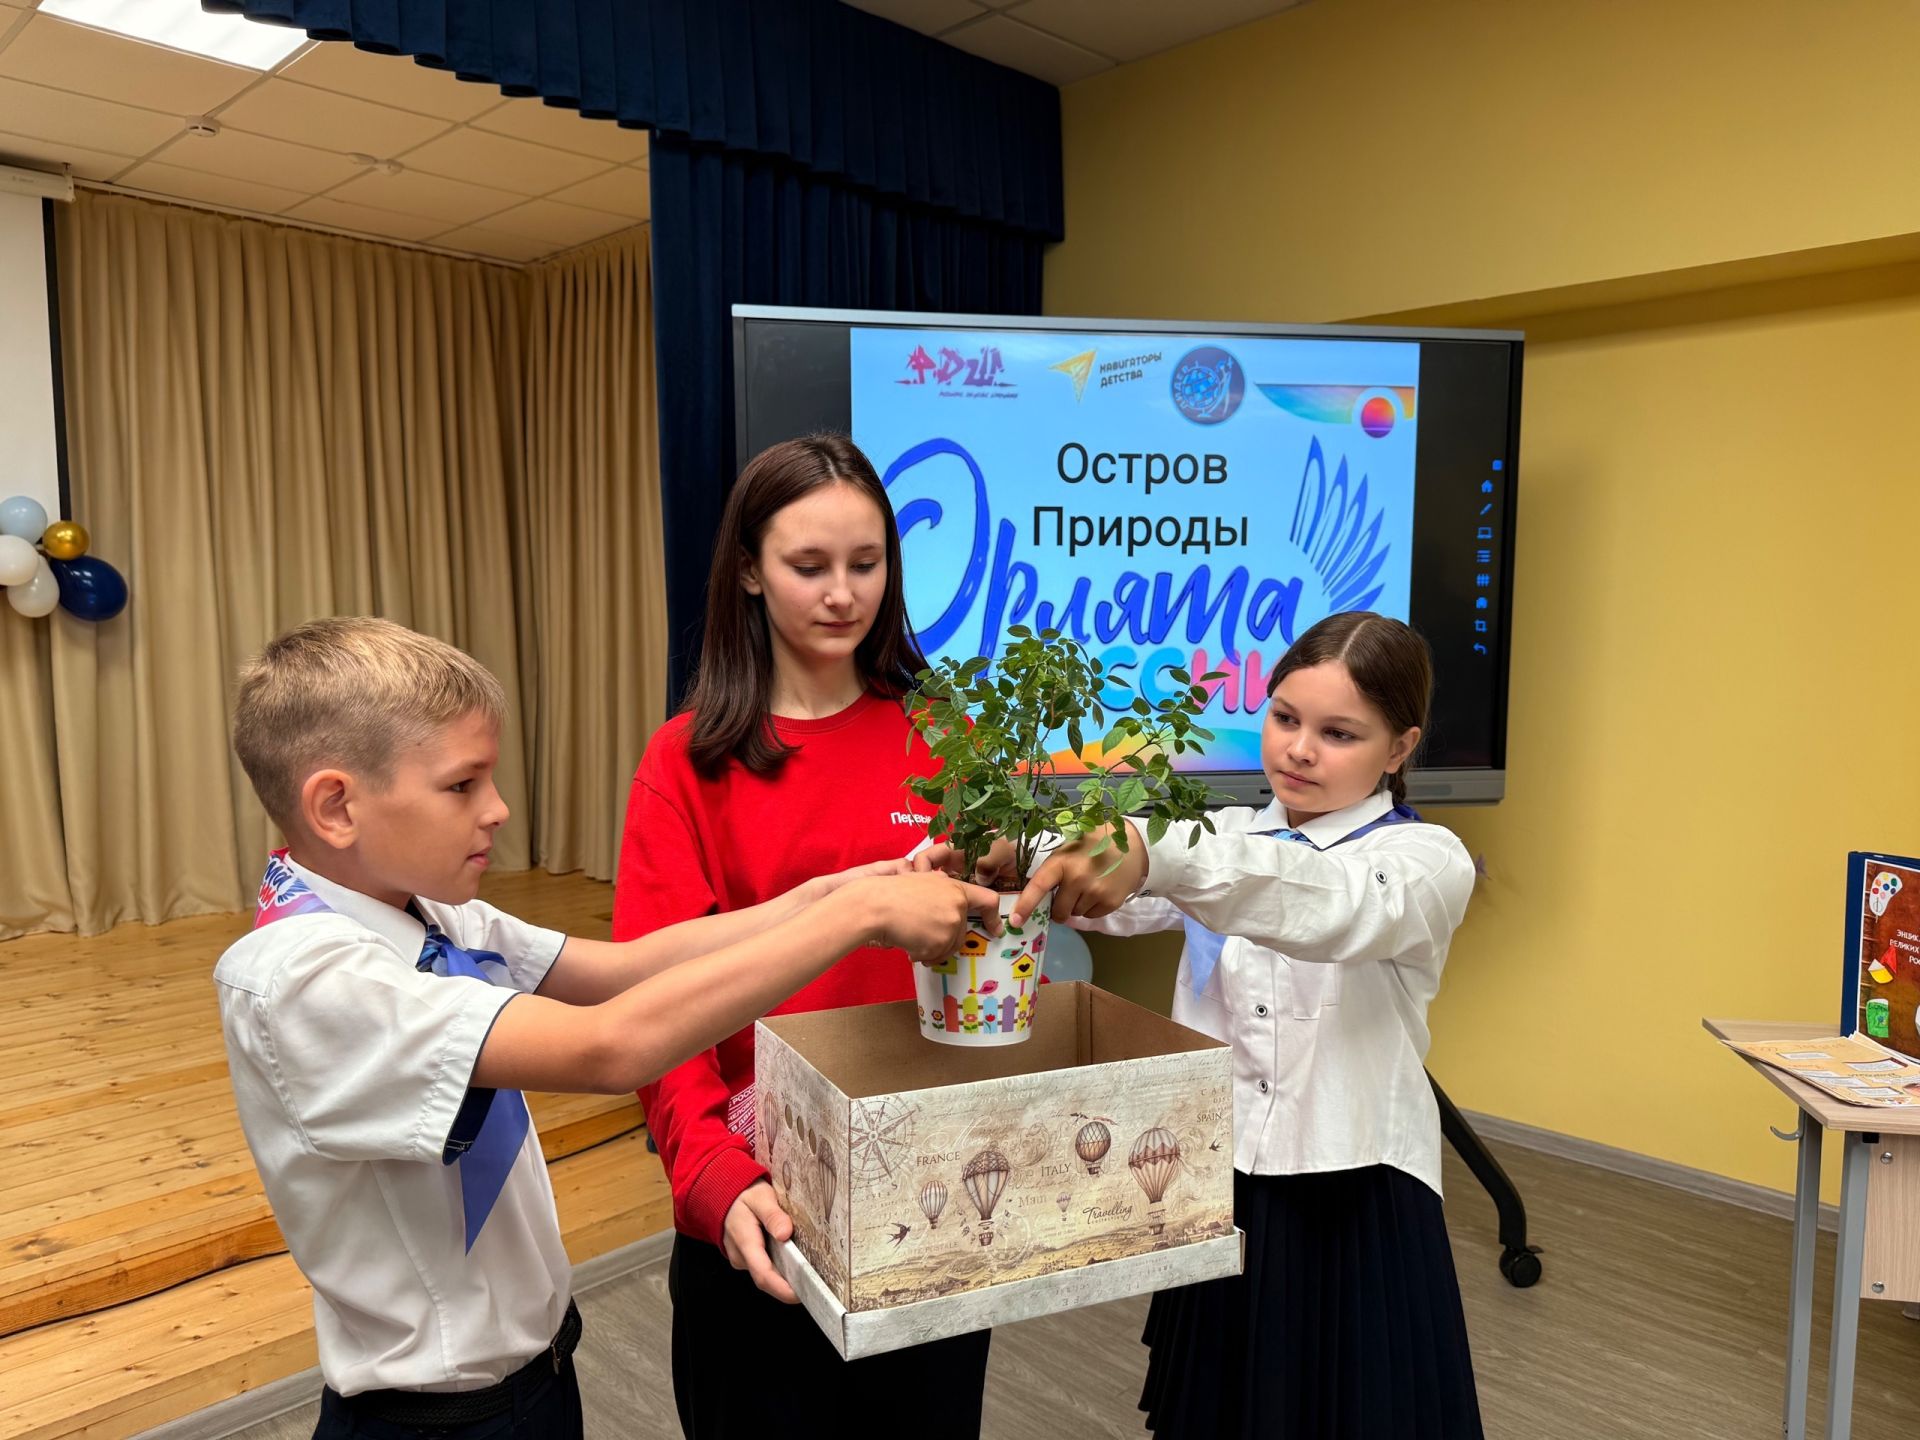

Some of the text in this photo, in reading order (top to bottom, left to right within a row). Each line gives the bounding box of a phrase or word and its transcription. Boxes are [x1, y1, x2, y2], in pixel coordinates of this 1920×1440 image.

[1099, 352, 1162, 374] НАВИГАТОРЫ
[1100, 369, 1143, 388] ДЕТСТВА
[1056, 442, 1228, 494] Остров
[1033, 505, 1248, 556] Природы
[881, 437, 1304, 679] Орлята
[1889, 939, 1920, 954] ВЕЛИКИХ
[1196, 1111, 1223, 1123] SPAIN
[916, 1151, 961, 1167] FRANCE
[1041, 1162, 1072, 1177] ITALY
[1082, 1200, 1133, 1225] Travelling
